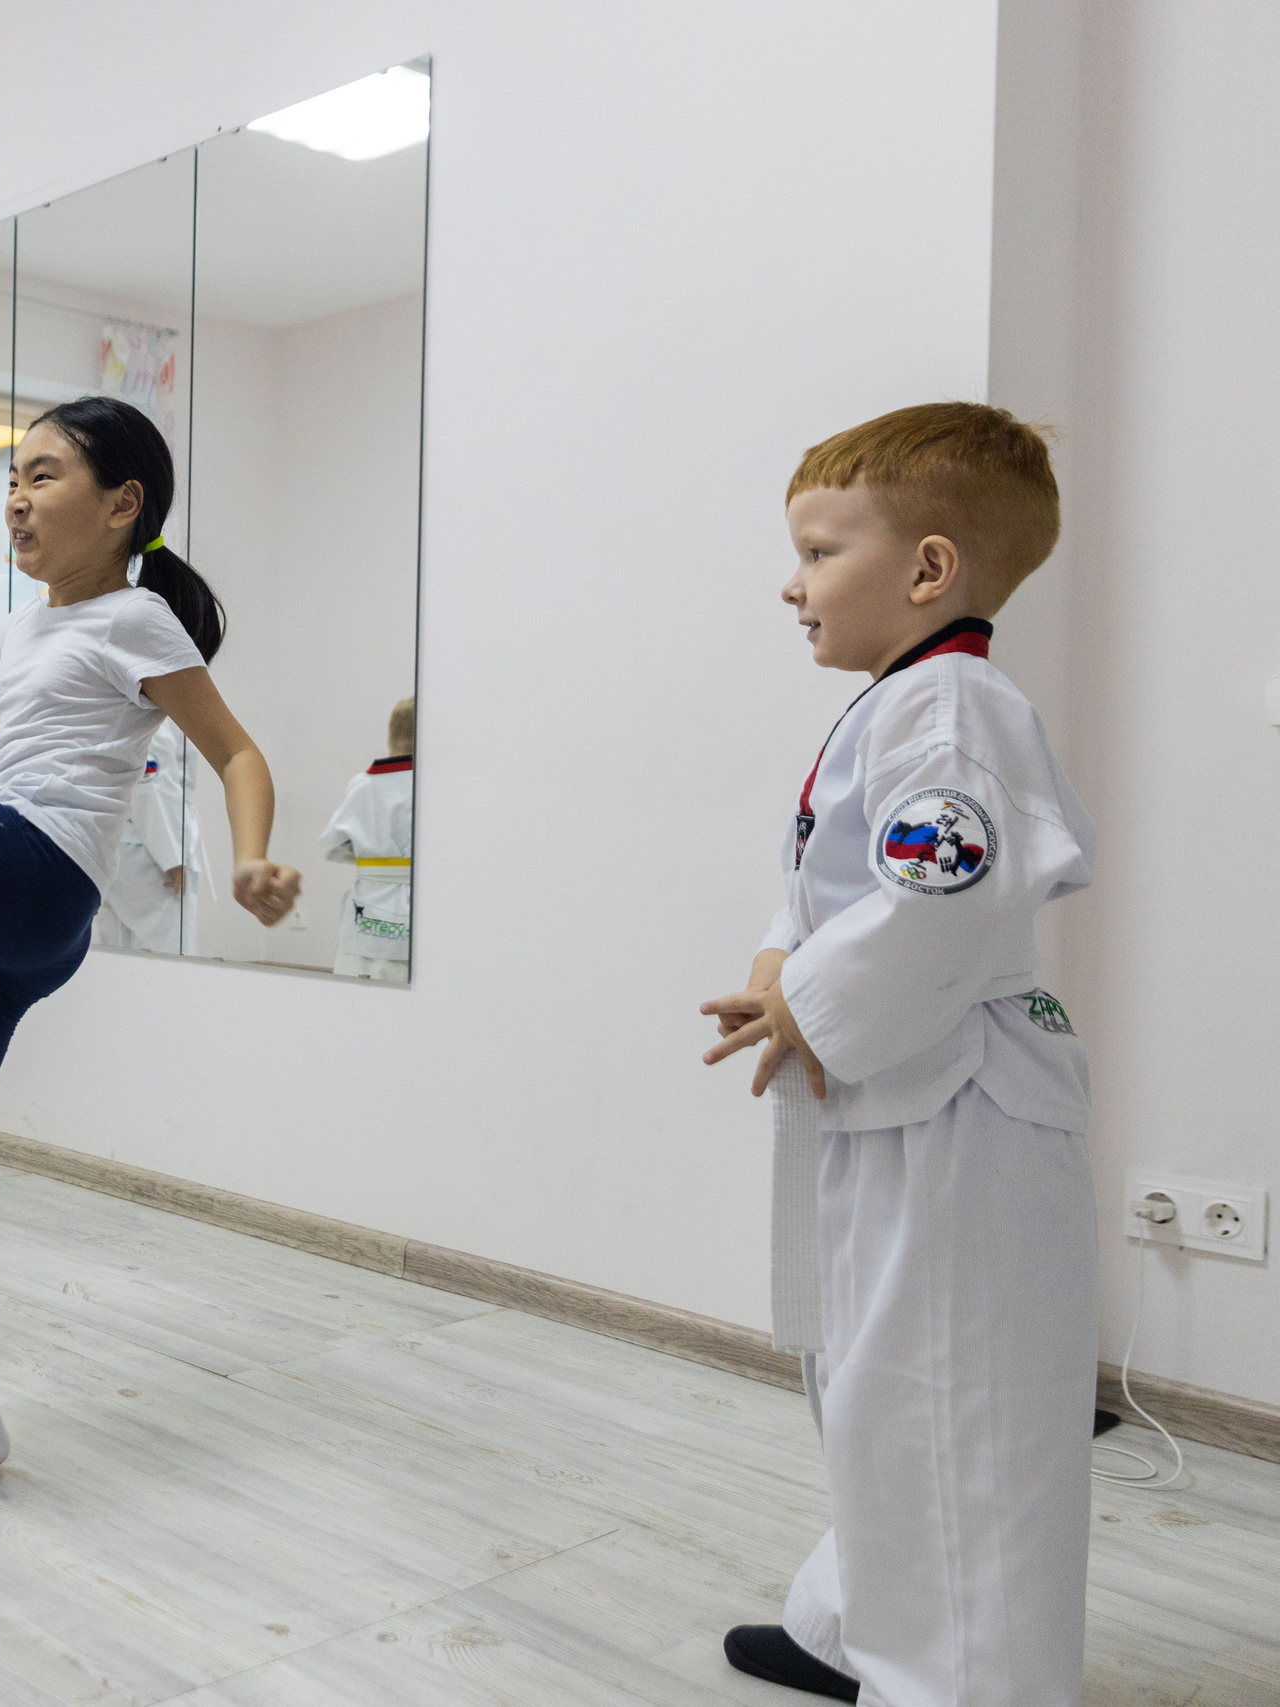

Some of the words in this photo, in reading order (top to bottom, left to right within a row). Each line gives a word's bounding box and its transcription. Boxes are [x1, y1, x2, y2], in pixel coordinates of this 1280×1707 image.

[908, 788, 958, 807] РАЗВИТИЯ
[958, 793, 990, 824] БОЕВЫХ
[983, 822, 997, 866] ИСКУССТВ
